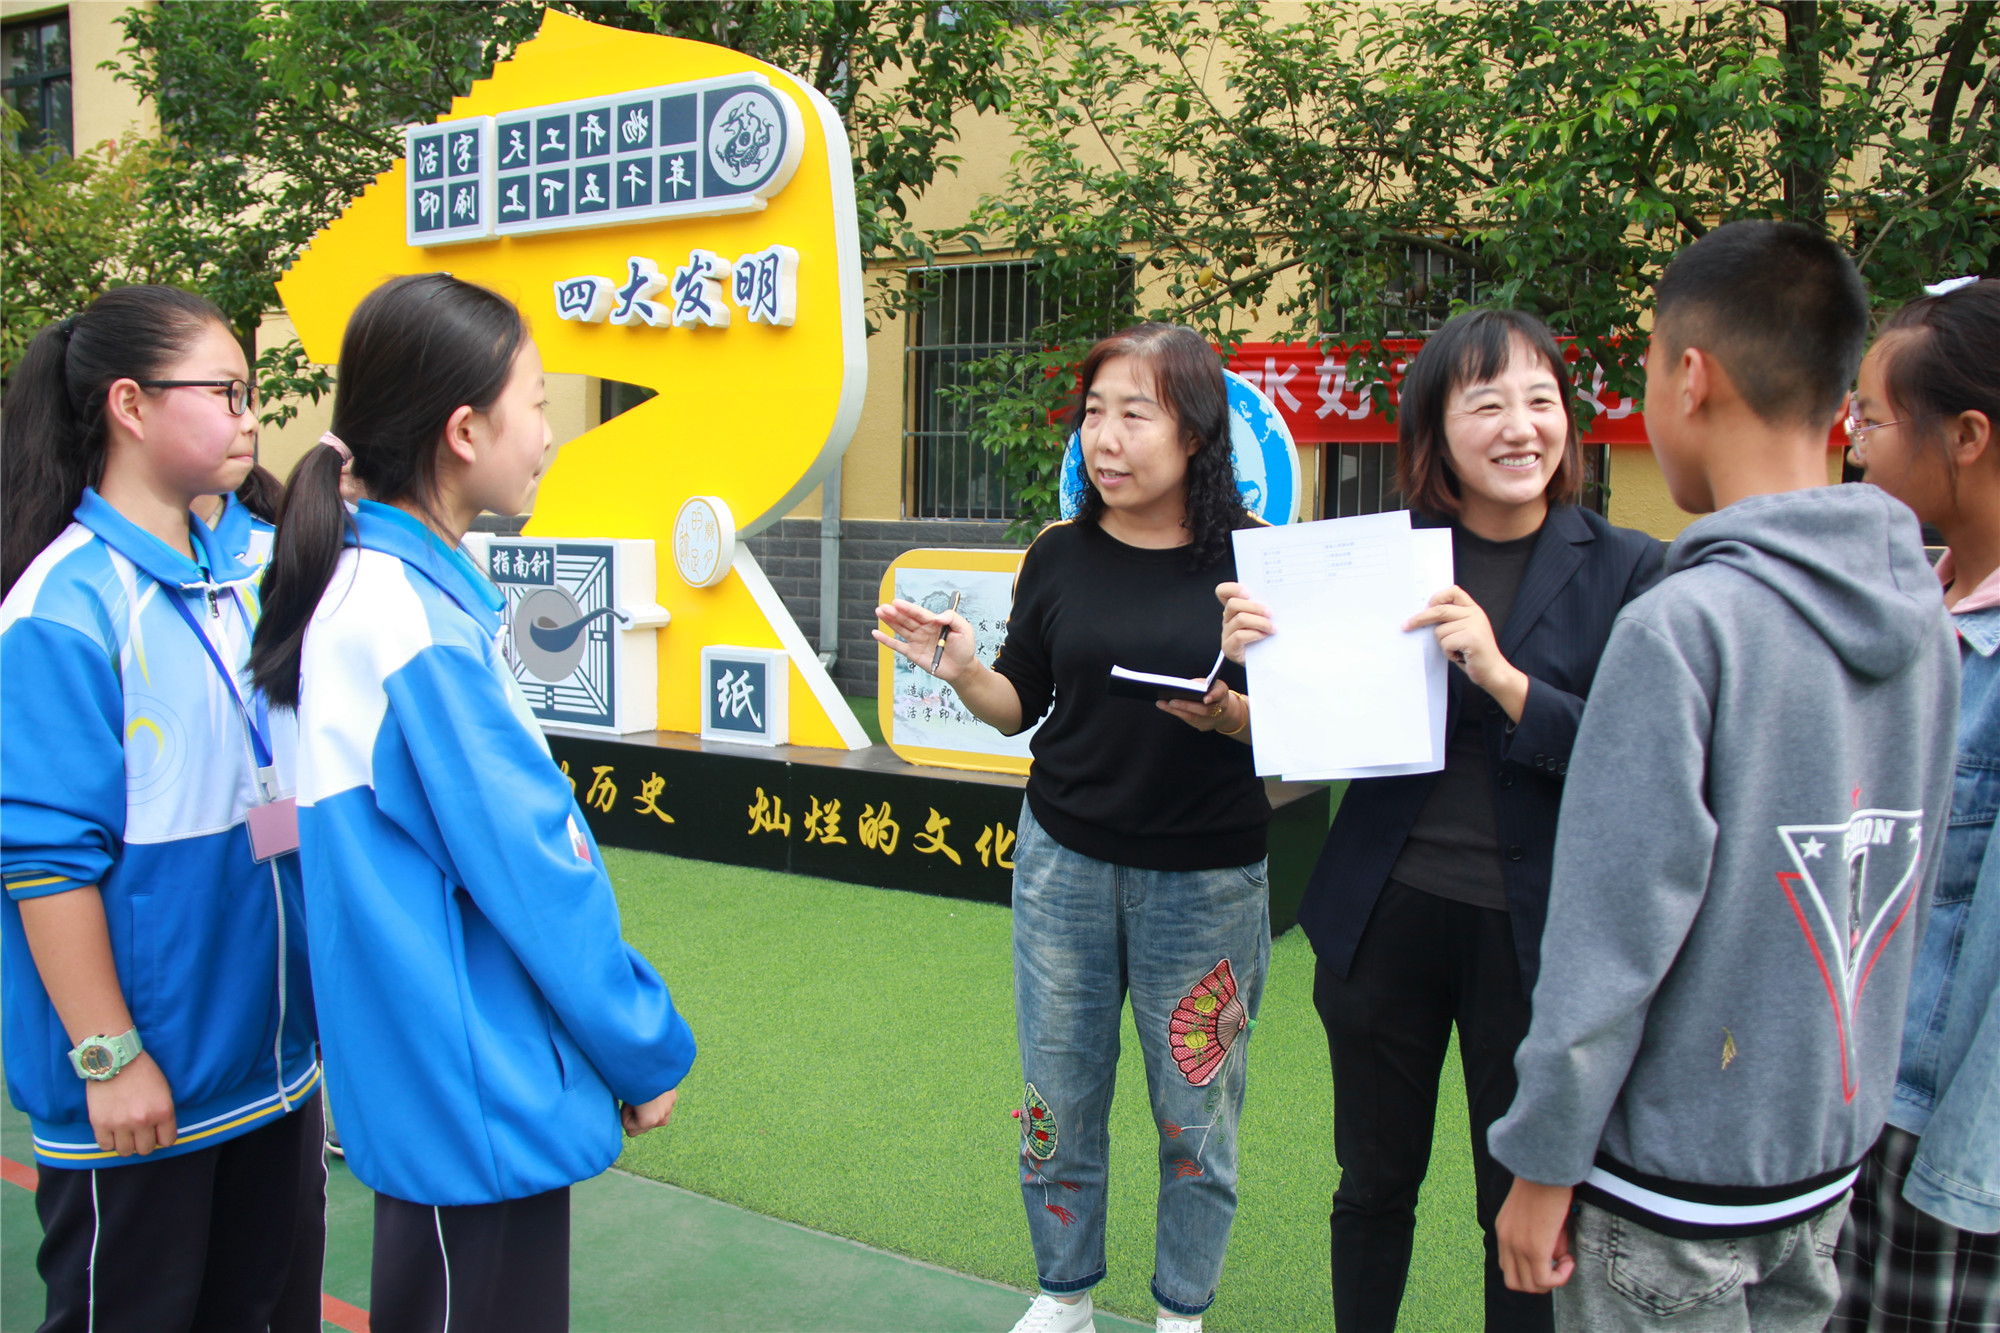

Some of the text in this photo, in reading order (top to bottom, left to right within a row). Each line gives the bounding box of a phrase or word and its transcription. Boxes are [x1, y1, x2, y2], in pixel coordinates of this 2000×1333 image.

[419, 133, 474, 175] 活字
[418, 185, 476, 229] 印刷
[556, 250, 781, 321] 四大发明
[492, 548, 551, 583] 指南针
[965, 617, 1006, 634] 发明
[716, 668, 762, 728] 纸
[747, 786, 1016, 870] 灿烂的文化
